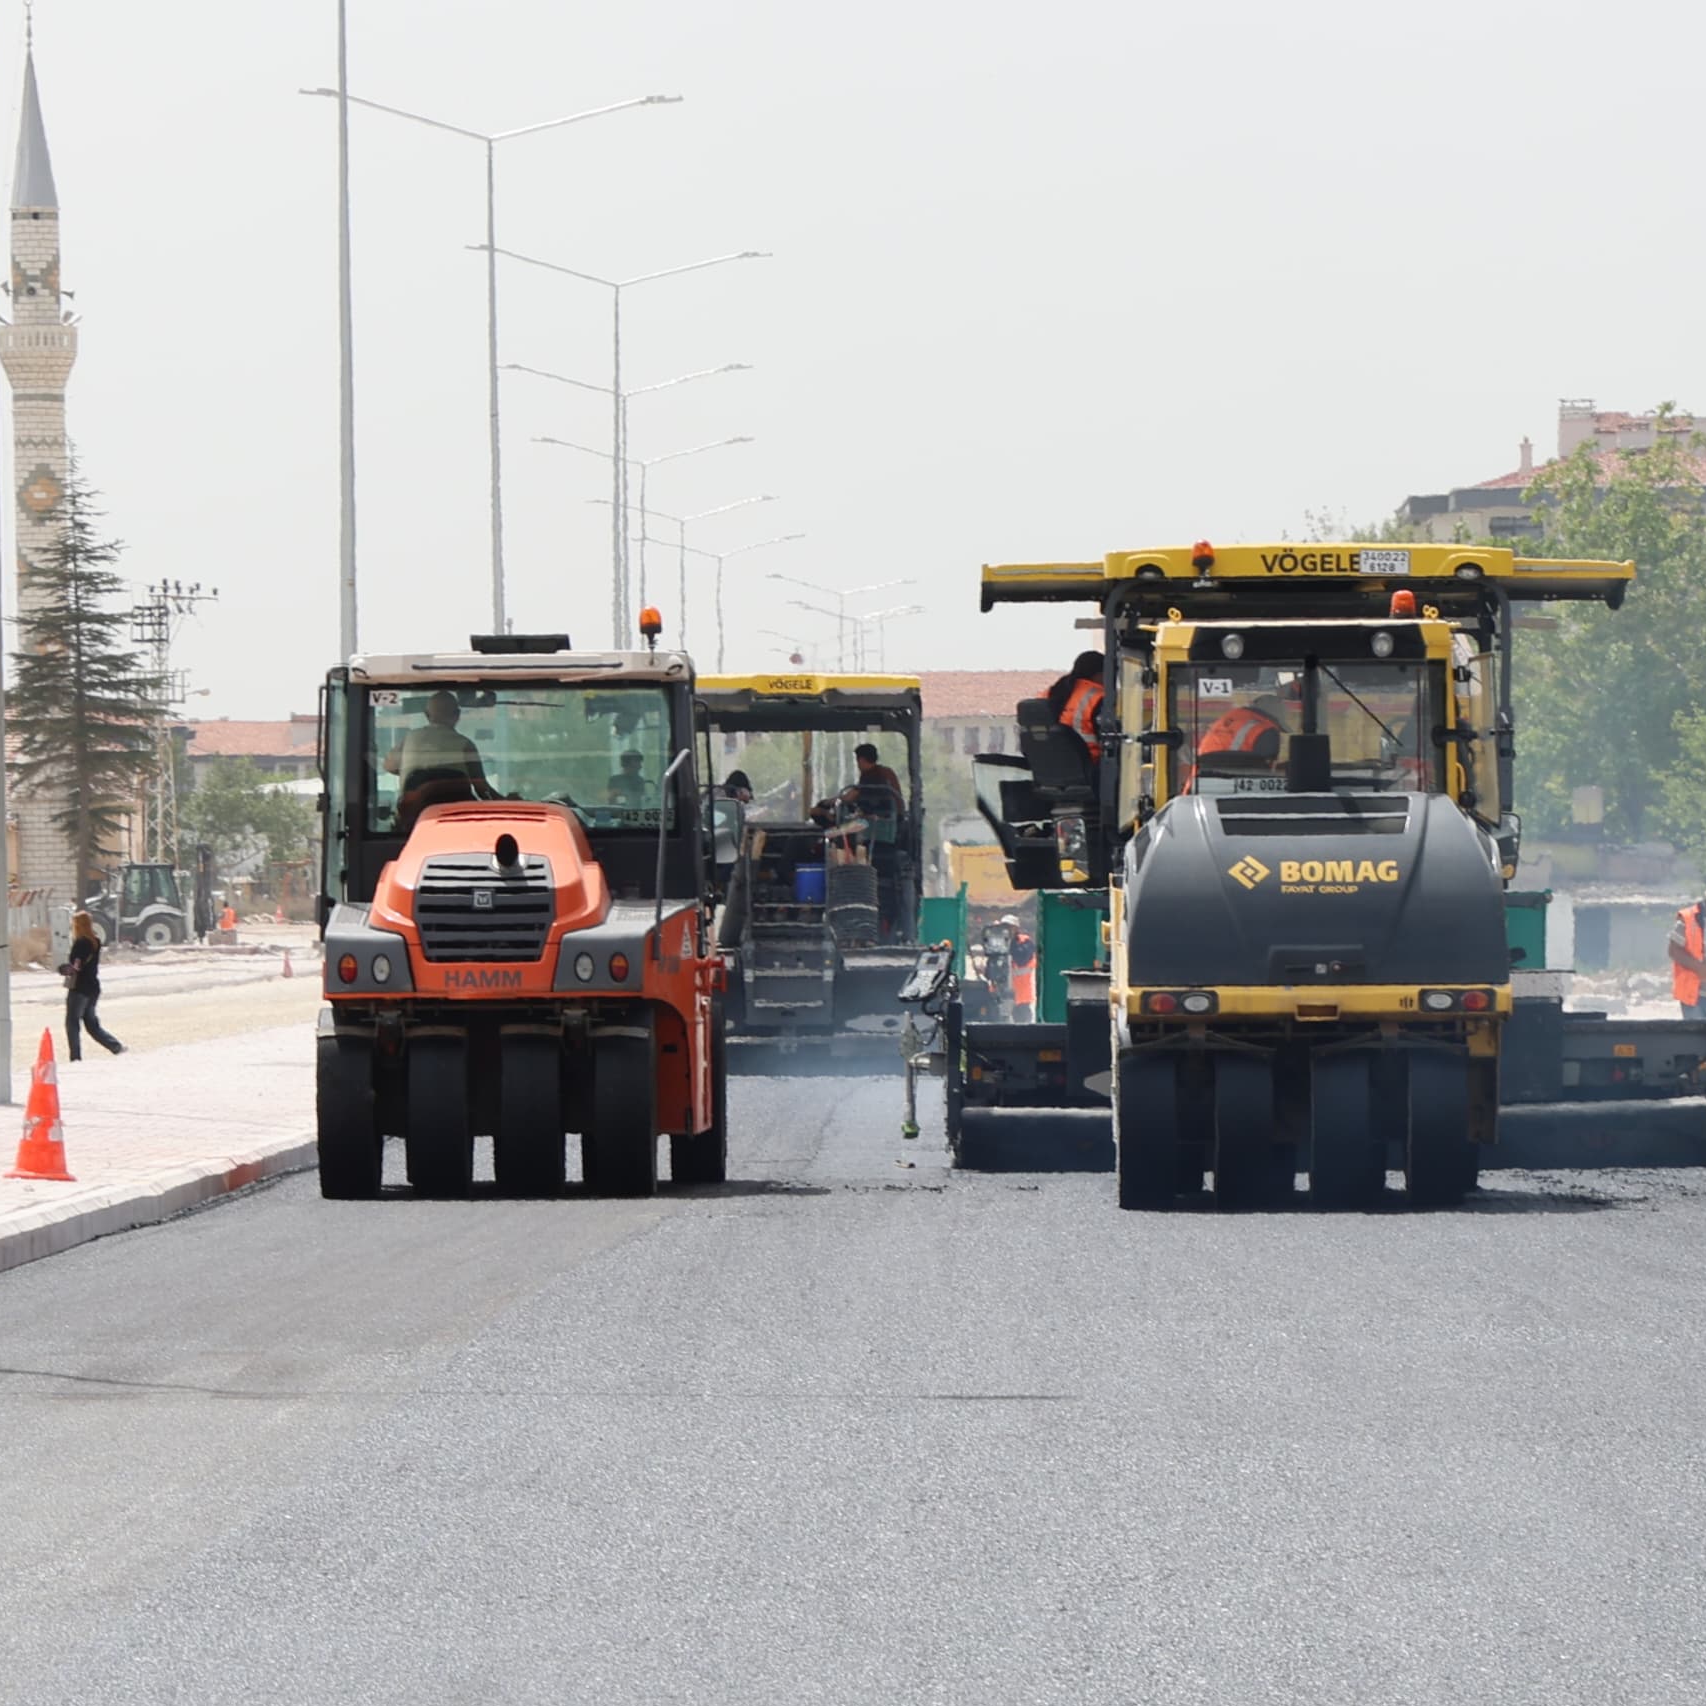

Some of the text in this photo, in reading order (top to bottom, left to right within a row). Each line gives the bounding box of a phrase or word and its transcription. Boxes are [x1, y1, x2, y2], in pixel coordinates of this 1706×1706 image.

[1261, 548, 1360, 572] VÖGELE
[766, 678, 813, 690] VÖGELE
[1203, 682, 1229, 694] V-1
[373, 692, 397, 705] V-2
[1280, 860, 1399, 882] BOMAG
[1319, 885, 1359, 894] GROUP
[444, 969, 522, 988] HAMM
